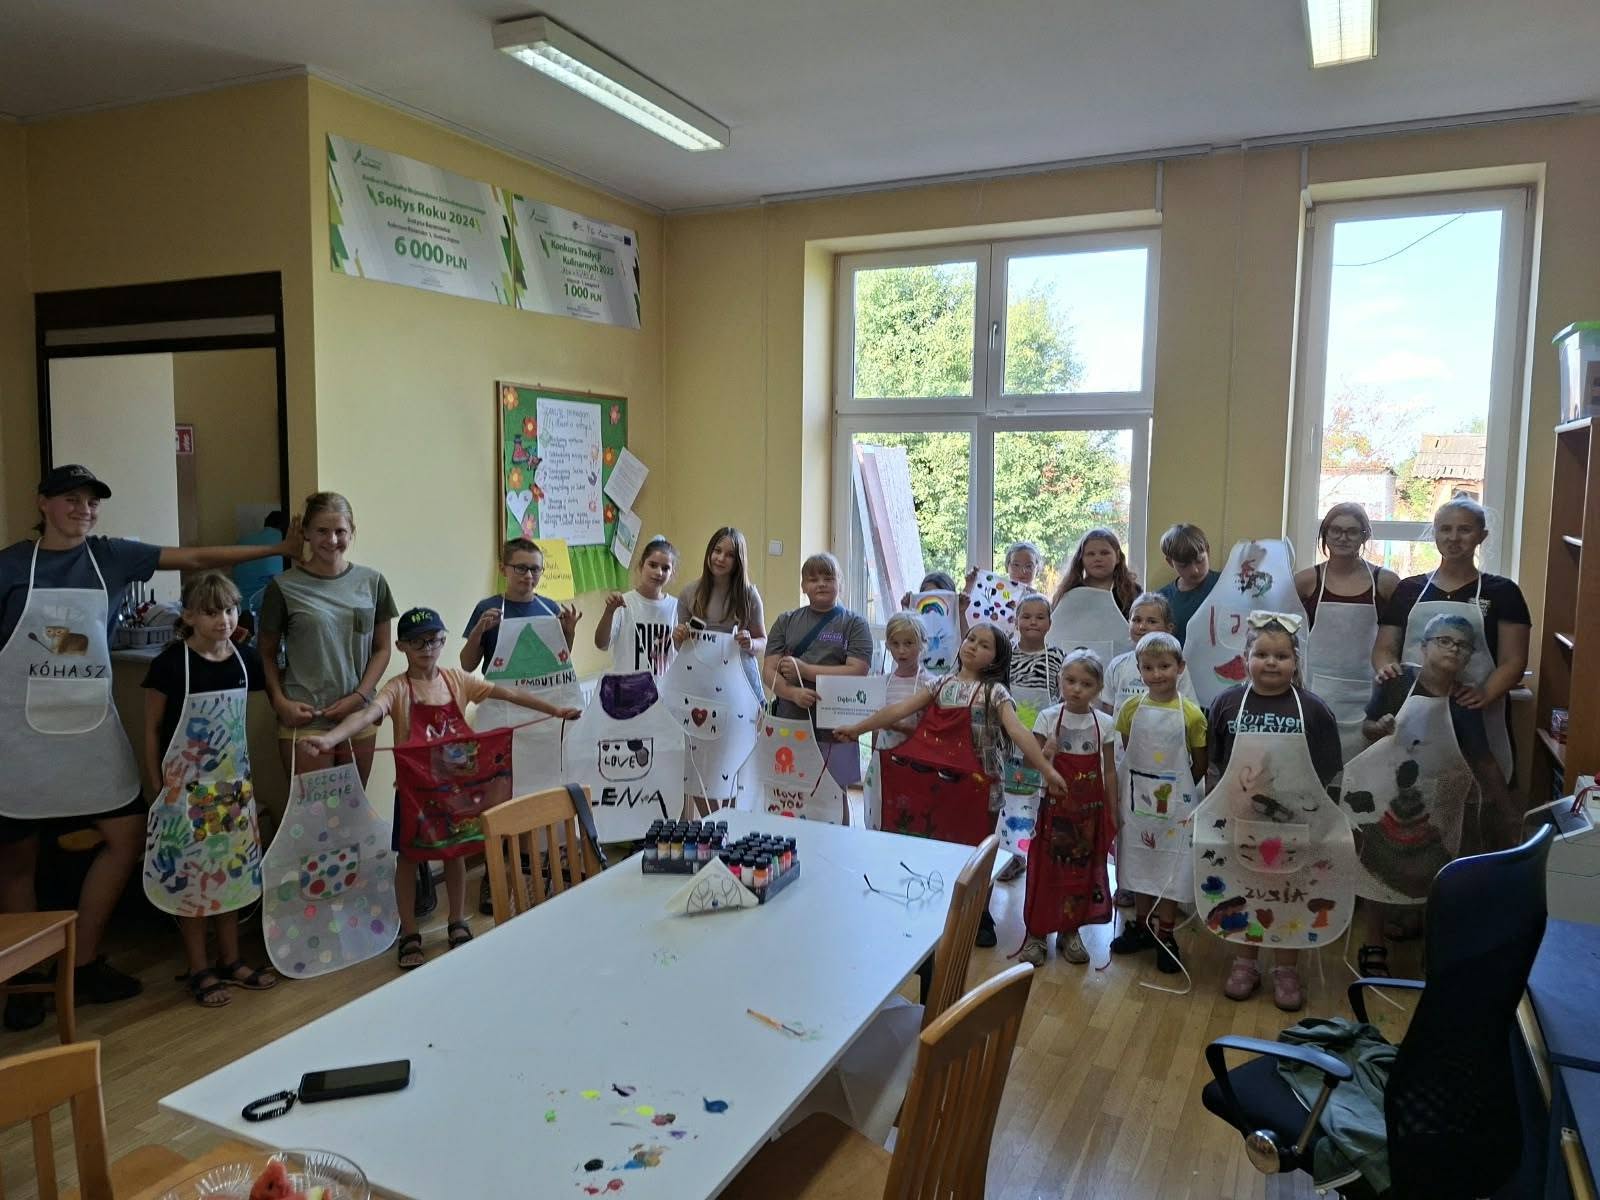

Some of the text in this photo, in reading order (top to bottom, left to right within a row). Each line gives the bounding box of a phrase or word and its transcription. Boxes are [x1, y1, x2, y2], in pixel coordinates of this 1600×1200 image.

[377, 191, 415, 214] Sołtys
[417, 201, 447, 221] Roku
[449, 212, 476, 228] 2024
[394, 235, 407, 256] 6
[410, 239, 444, 264] 000
[446, 253, 468, 270] PLN
[551, 239, 578, 255] Konkurs
[578, 247, 602, 263] Tradycji
[562, 255, 599, 273] Kulinarnych
[564, 283, 570, 296] 1
[571, 284, 589, 300] 000
[29, 661, 106, 678] KÓHASZ
[604, 754, 636, 769] LOVE
[780, 799, 803, 809] YOU
